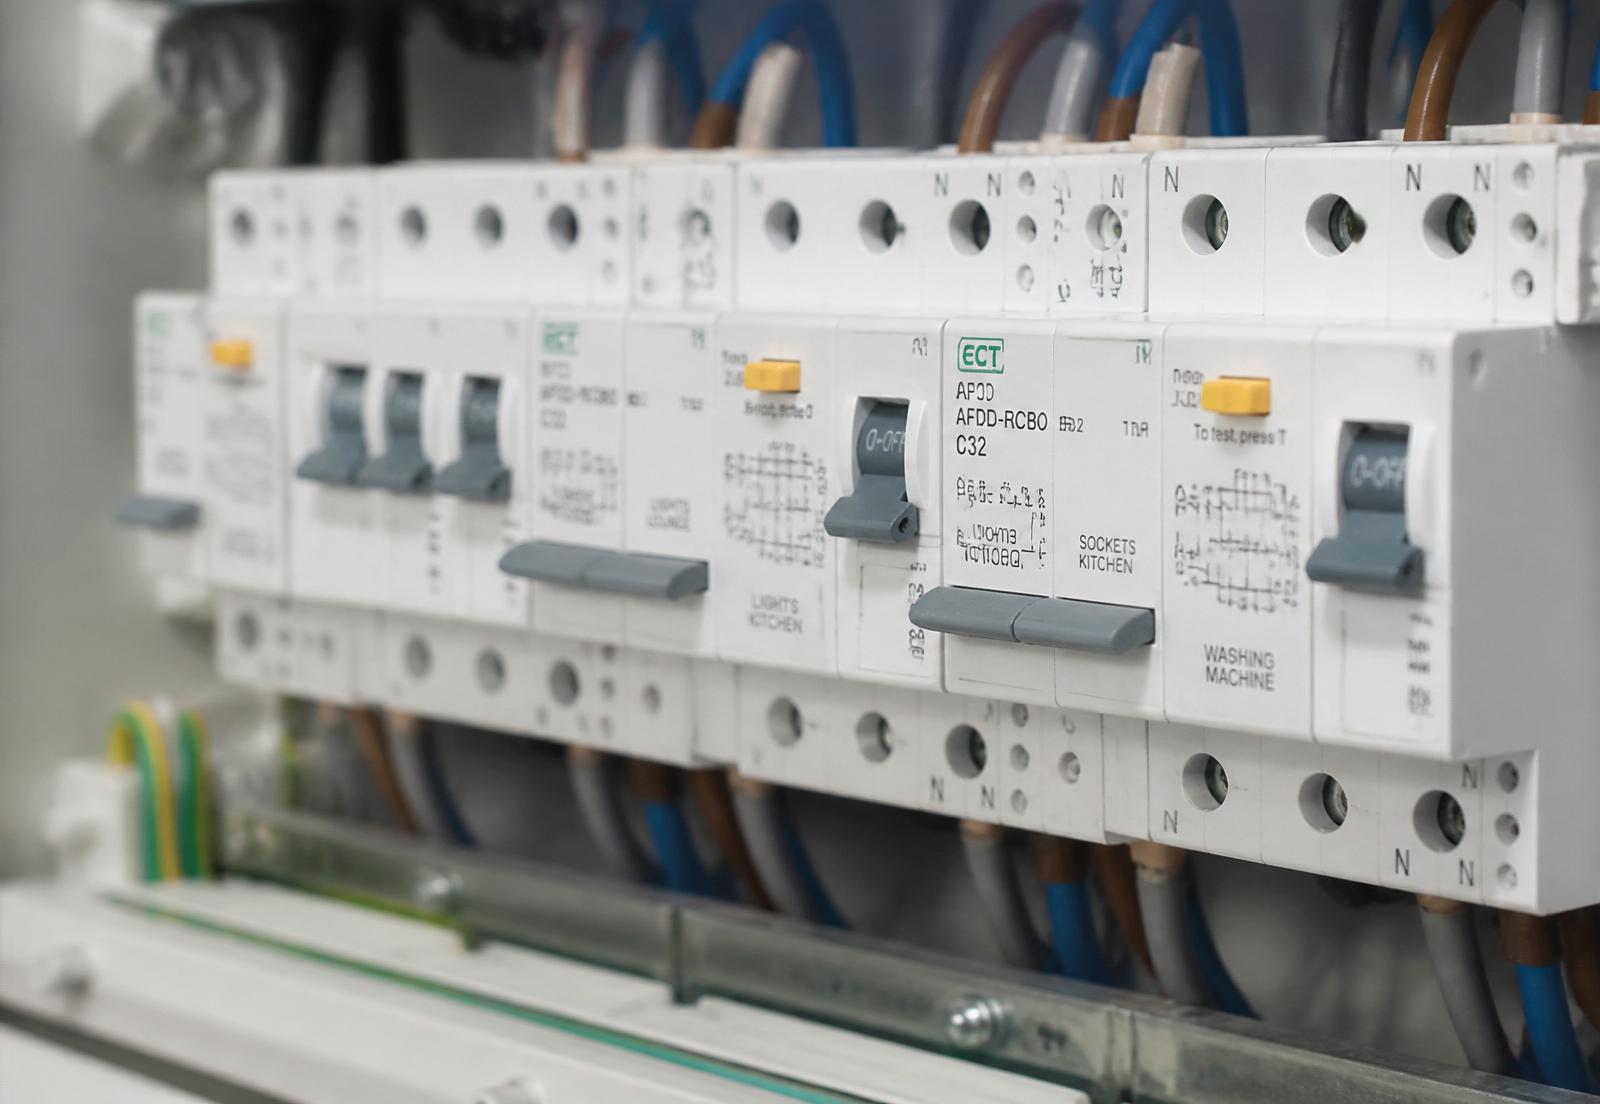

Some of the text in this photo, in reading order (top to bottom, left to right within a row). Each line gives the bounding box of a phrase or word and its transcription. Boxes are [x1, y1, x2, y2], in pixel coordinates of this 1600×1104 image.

[934, 172, 949, 197] N
[987, 172, 1001, 198] N
[1112, 174, 1124, 199] N
[1164, 166, 1179, 193] N
[1406, 163, 1421, 192] N
[1473, 163, 1490, 192] N
[961, 343, 1003, 369] ECT
[956, 407, 1048, 432] AFDD-RCBO
[956, 434, 987, 457] C32
[1079, 534, 1137, 556] SOCKETS
[1079, 553, 1133, 575] KITCHEN
[751, 593, 800, 615] LIGHTS
[748, 611, 804, 635] KITCHEN
[1203, 643, 1276, 671] WASHING
[1205, 666, 1276, 692] MACHINE
[1163, 809, 1178, 834] N
[1395, 847, 1410, 877] N
[1458, 859, 1475, 887] N
